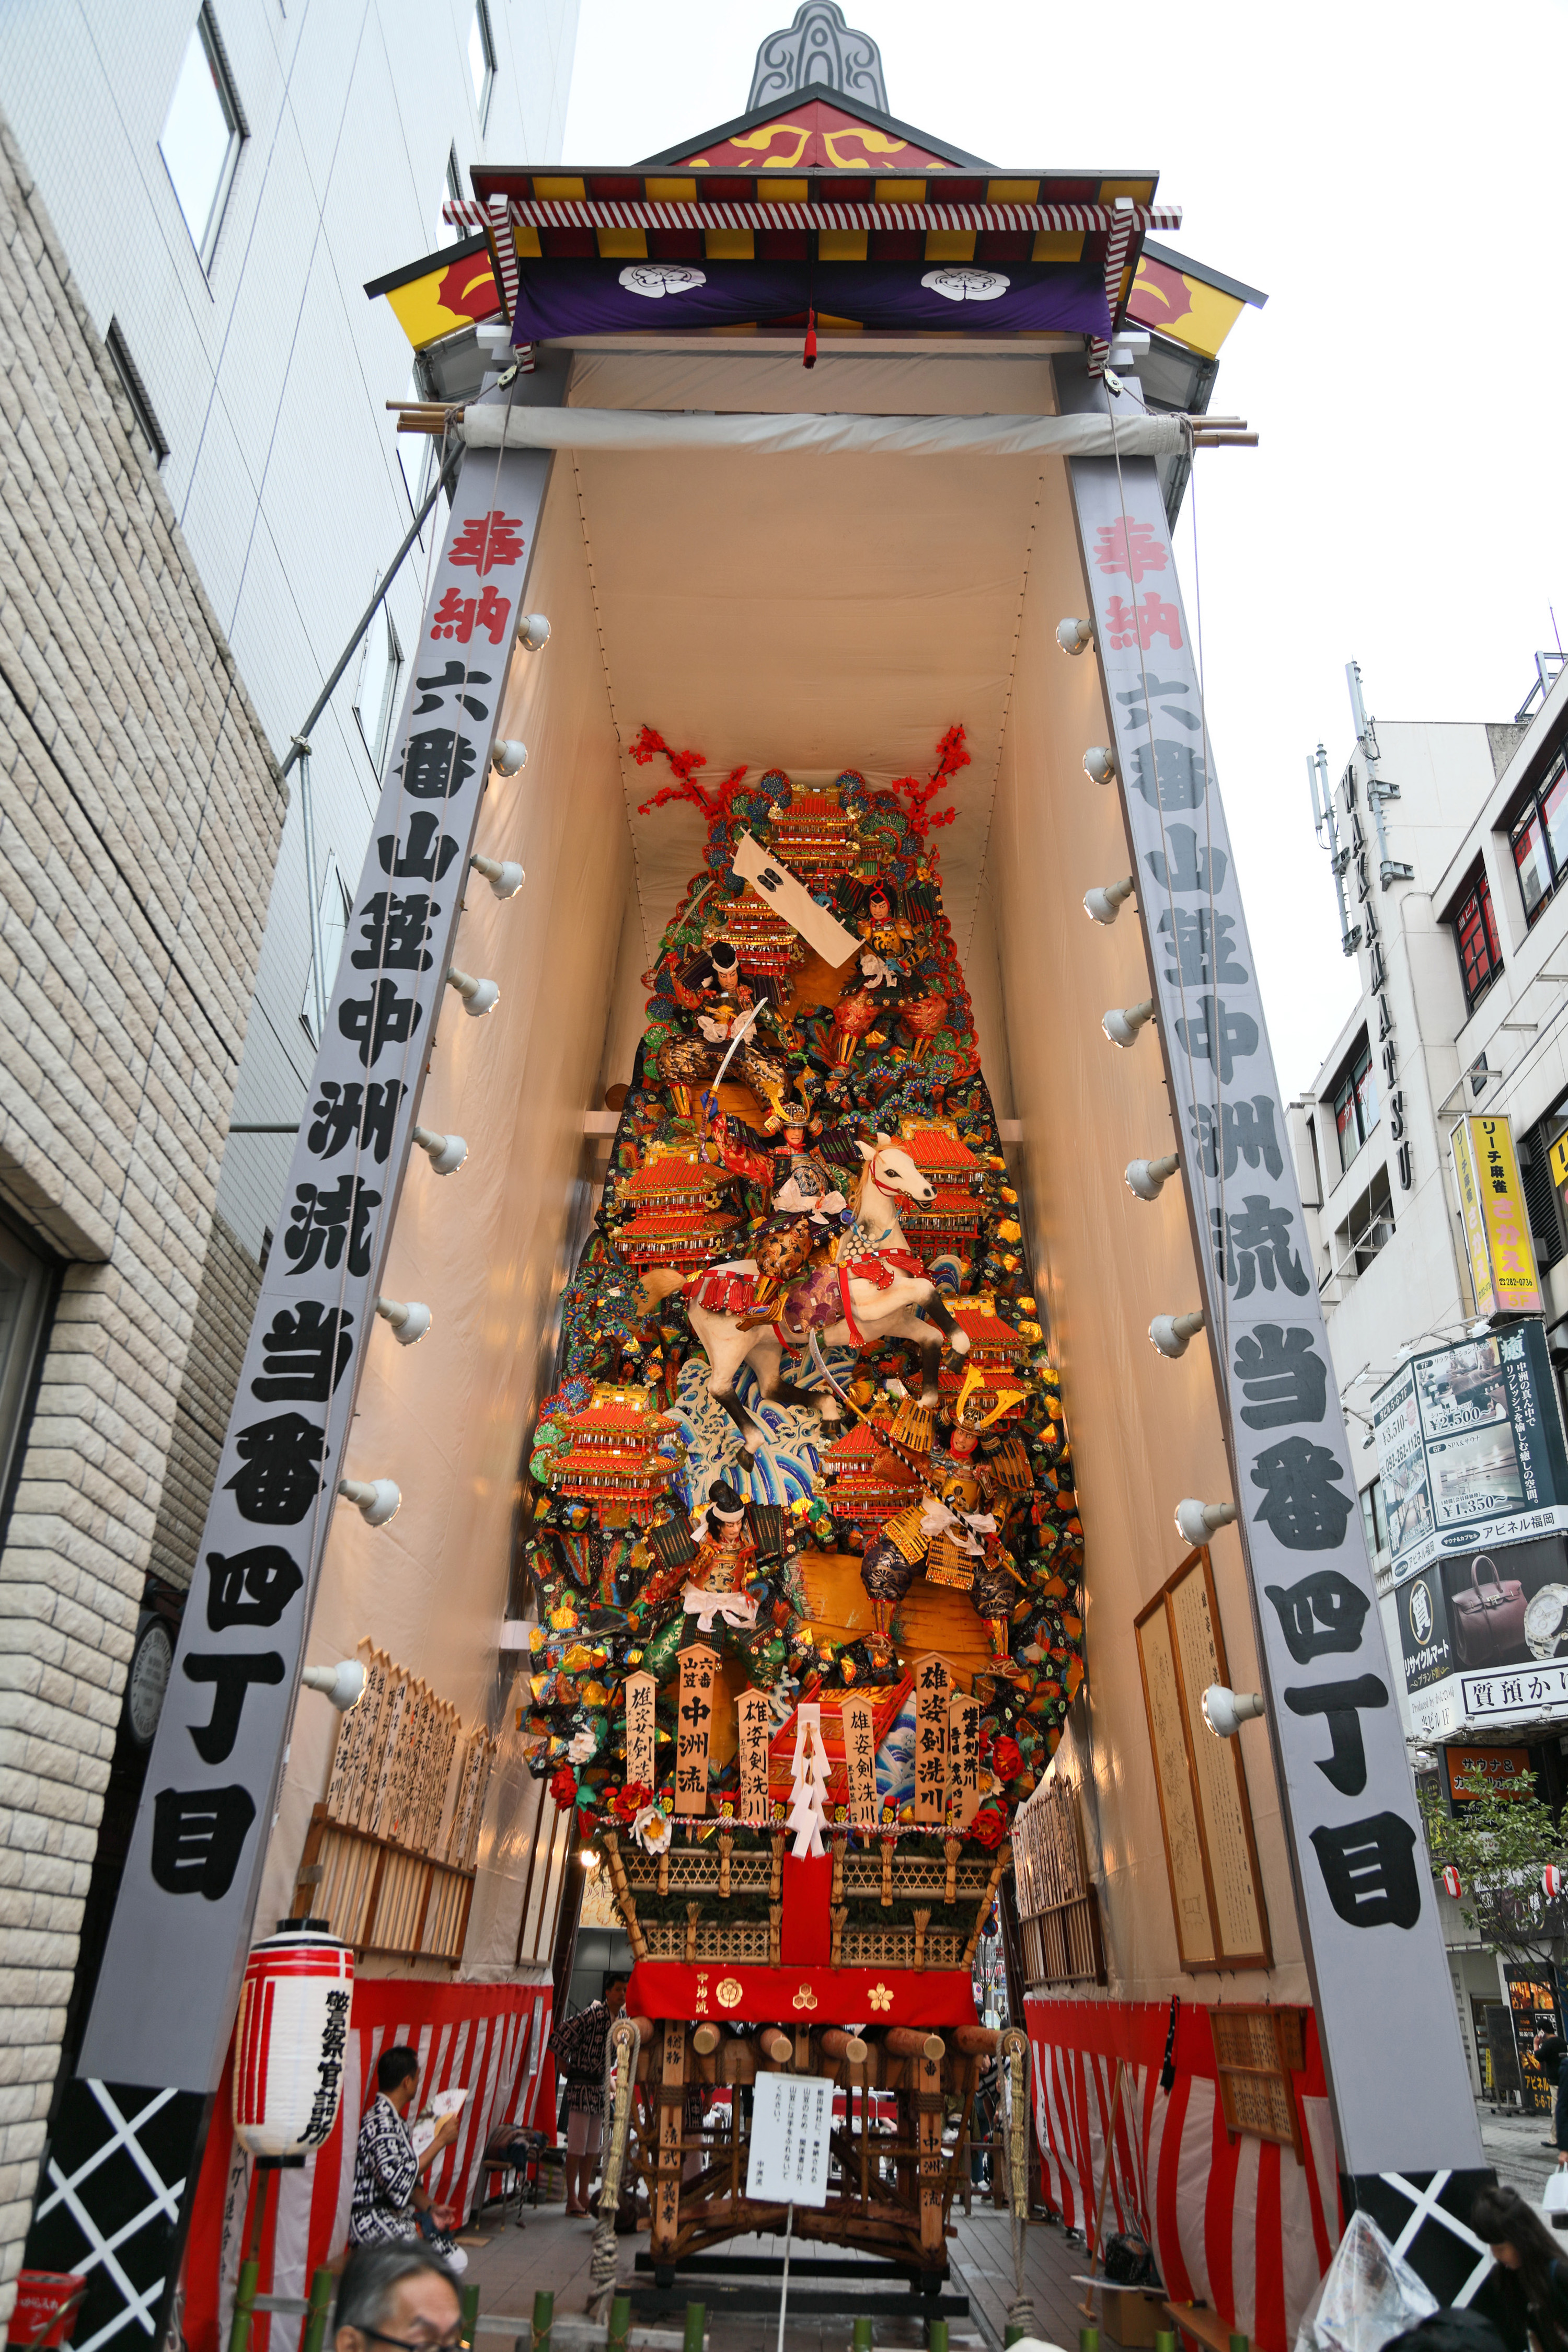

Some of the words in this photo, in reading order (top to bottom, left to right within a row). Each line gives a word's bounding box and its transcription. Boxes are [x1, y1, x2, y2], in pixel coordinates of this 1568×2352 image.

[1457, 1129, 1473, 1203] リーチ麻雀
[1483, 1122, 1508, 1193] リーチ麻雀
[1468, 1206, 1487, 1284] さかえ
[1492, 1197, 1525, 1273] さかえ
[1508, 1294, 1529, 1307] 5F
[1420, 1360, 1429, 1369] 7F
[1516, 1362, 1537, 1427] 中洲の真ん中で
[1432, 1445, 1442, 1454] 6F
[1408, 1540, 1436, 1569] アビネル福岡
[1443, 1532, 1479, 1546] サウナ&カプセル
[1483, 1512, 1555, 1539] アビネル福岡
[1412, 1585, 1431, 1638] 質
[1404, 1639, 1449, 1677] リサイクルマート
[678, 1696, 711, 1793] 中洲流
[743, 1700, 769, 1820] 雄姿剣洗川
[850, 1710, 877, 1824] 雄姿剣洗川
[919, 1663, 948, 1813] 雄姿剣洗川
[951, 1727, 961, 1756] 五丁目
[961, 1706, 979, 1790] 雄姿剣洗川
[1462, 1758, 1515, 1772] サウナ&
[297, 1990, 350, 2145] 警察官詰所
[666, 2035, 682, 2065] 総務
[923, 2135, 940, 2207] 中洲流
